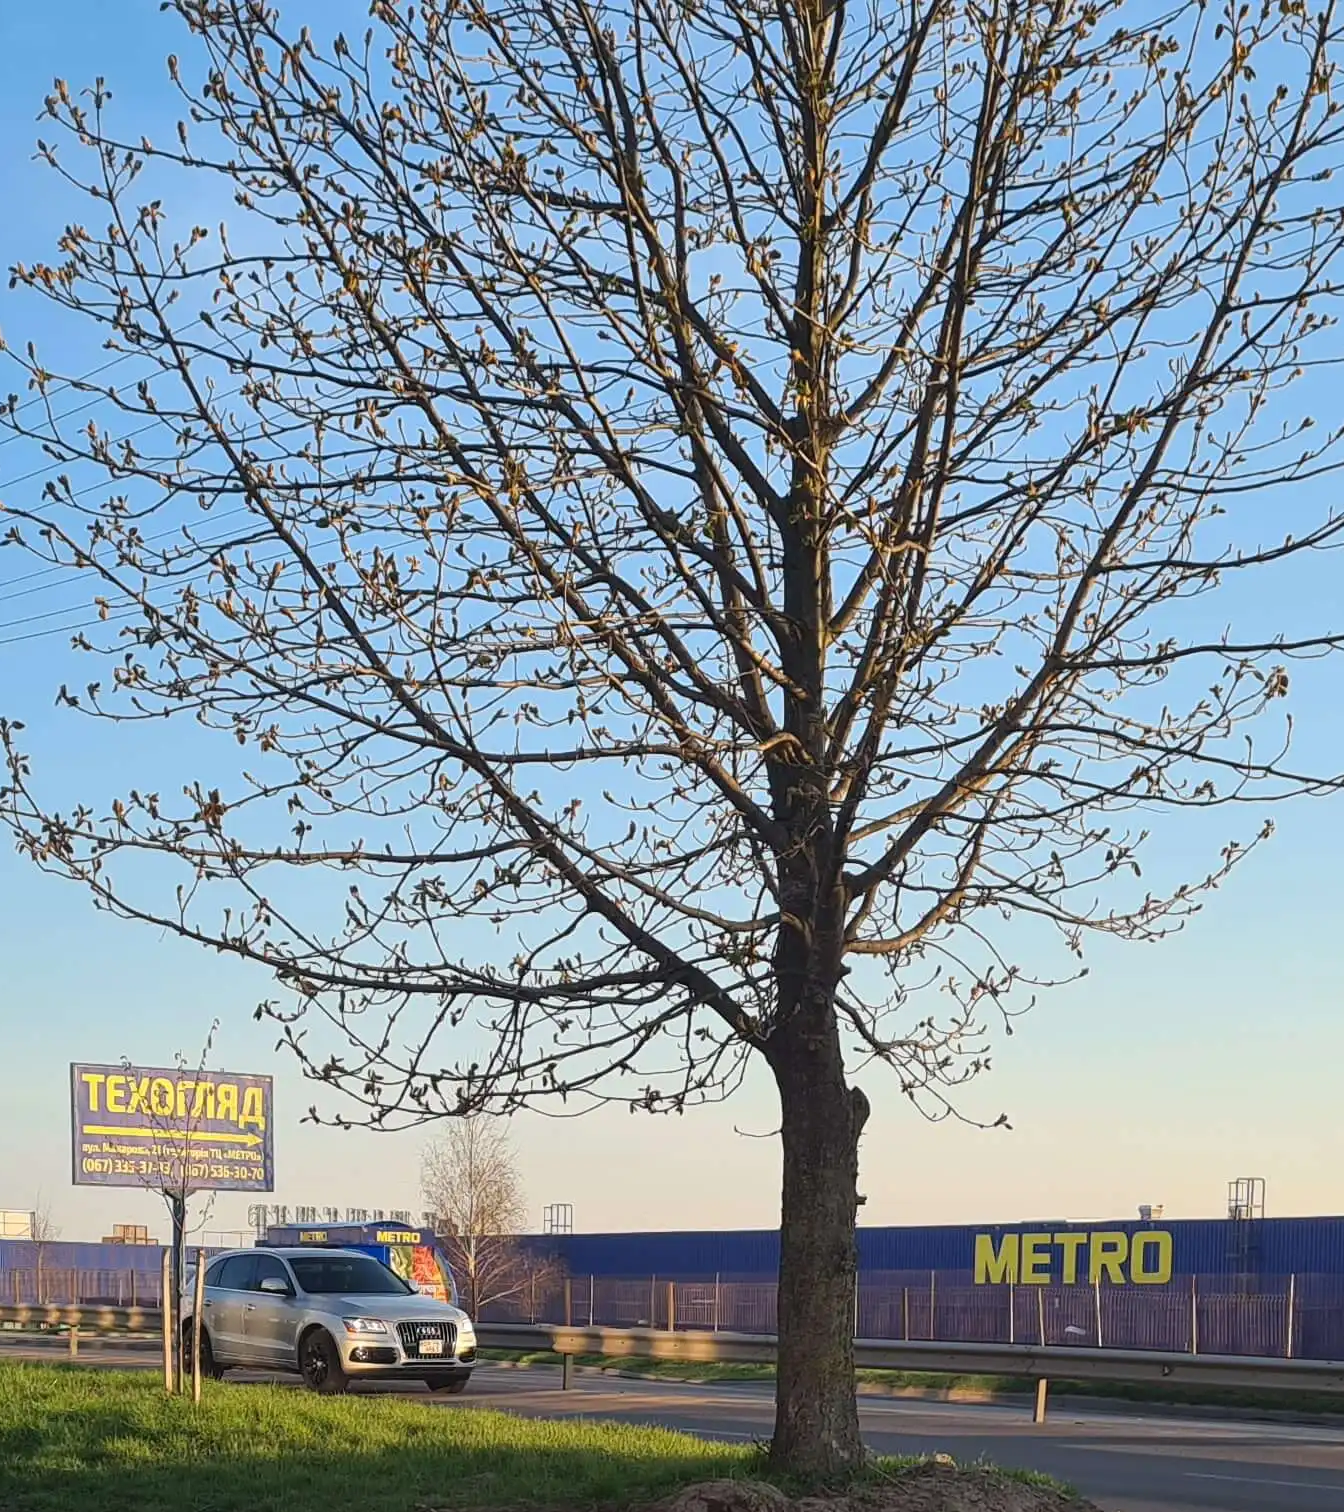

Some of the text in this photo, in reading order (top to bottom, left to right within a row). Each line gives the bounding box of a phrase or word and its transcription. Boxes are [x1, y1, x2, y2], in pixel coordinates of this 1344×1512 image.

[81, 1073, 266, 1131] ТЕХОГЛЯД
[82, 1157, 113, 1174] (067)
[299, 1231, 328, 1242] METRO
[376, 1230, 421, 1244] METRO
[974, 1230, 1173, 1285] METRO
